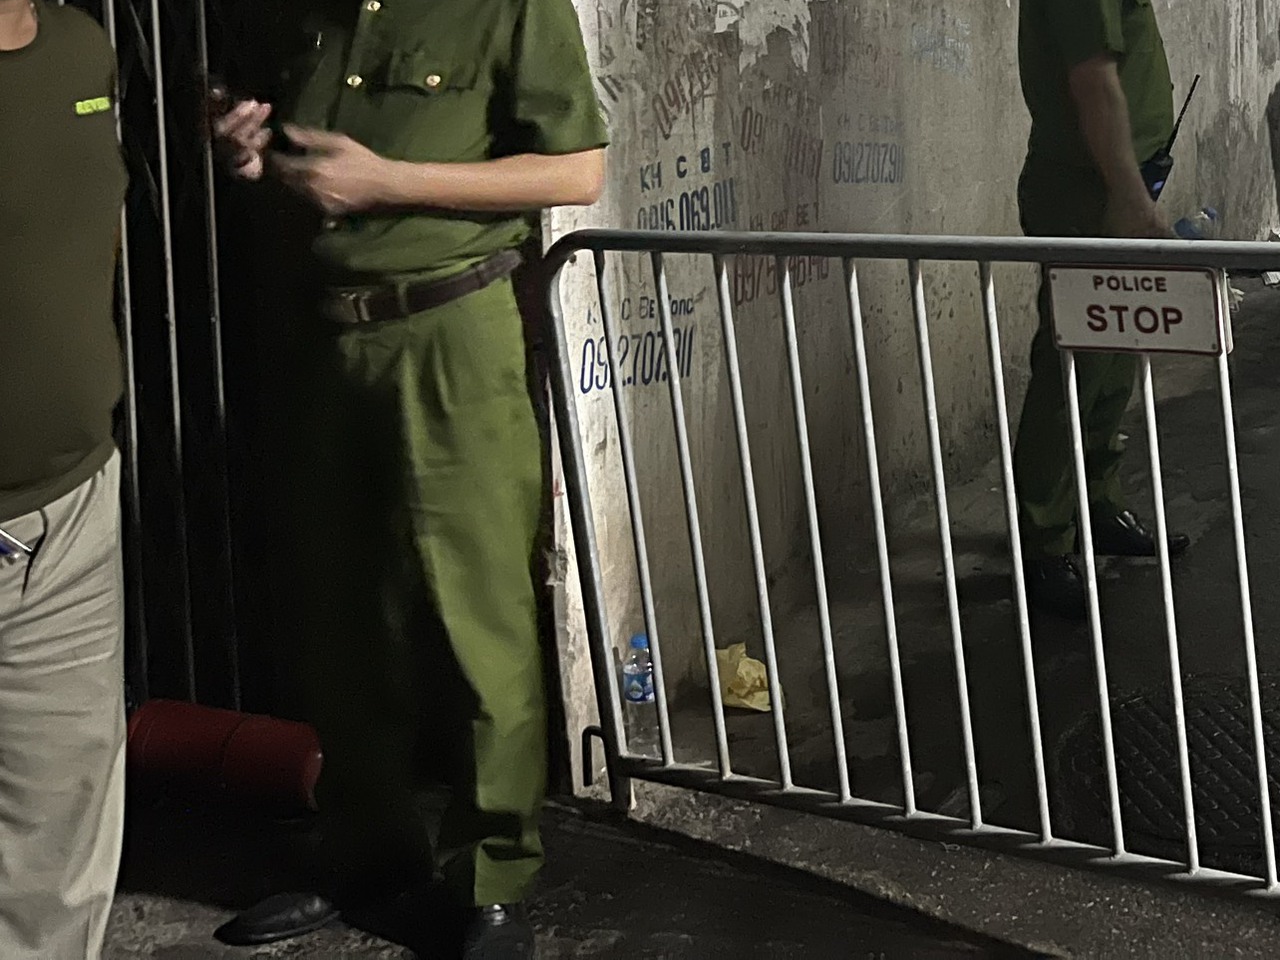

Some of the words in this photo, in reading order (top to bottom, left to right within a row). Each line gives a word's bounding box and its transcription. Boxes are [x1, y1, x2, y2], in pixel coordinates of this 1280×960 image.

[640, 161, 662, 193] KH
[676, 155, 687, 178] C
[1092, 275, 1167, 292] POLICE
[1086, 304, 1183, 334] STOP
